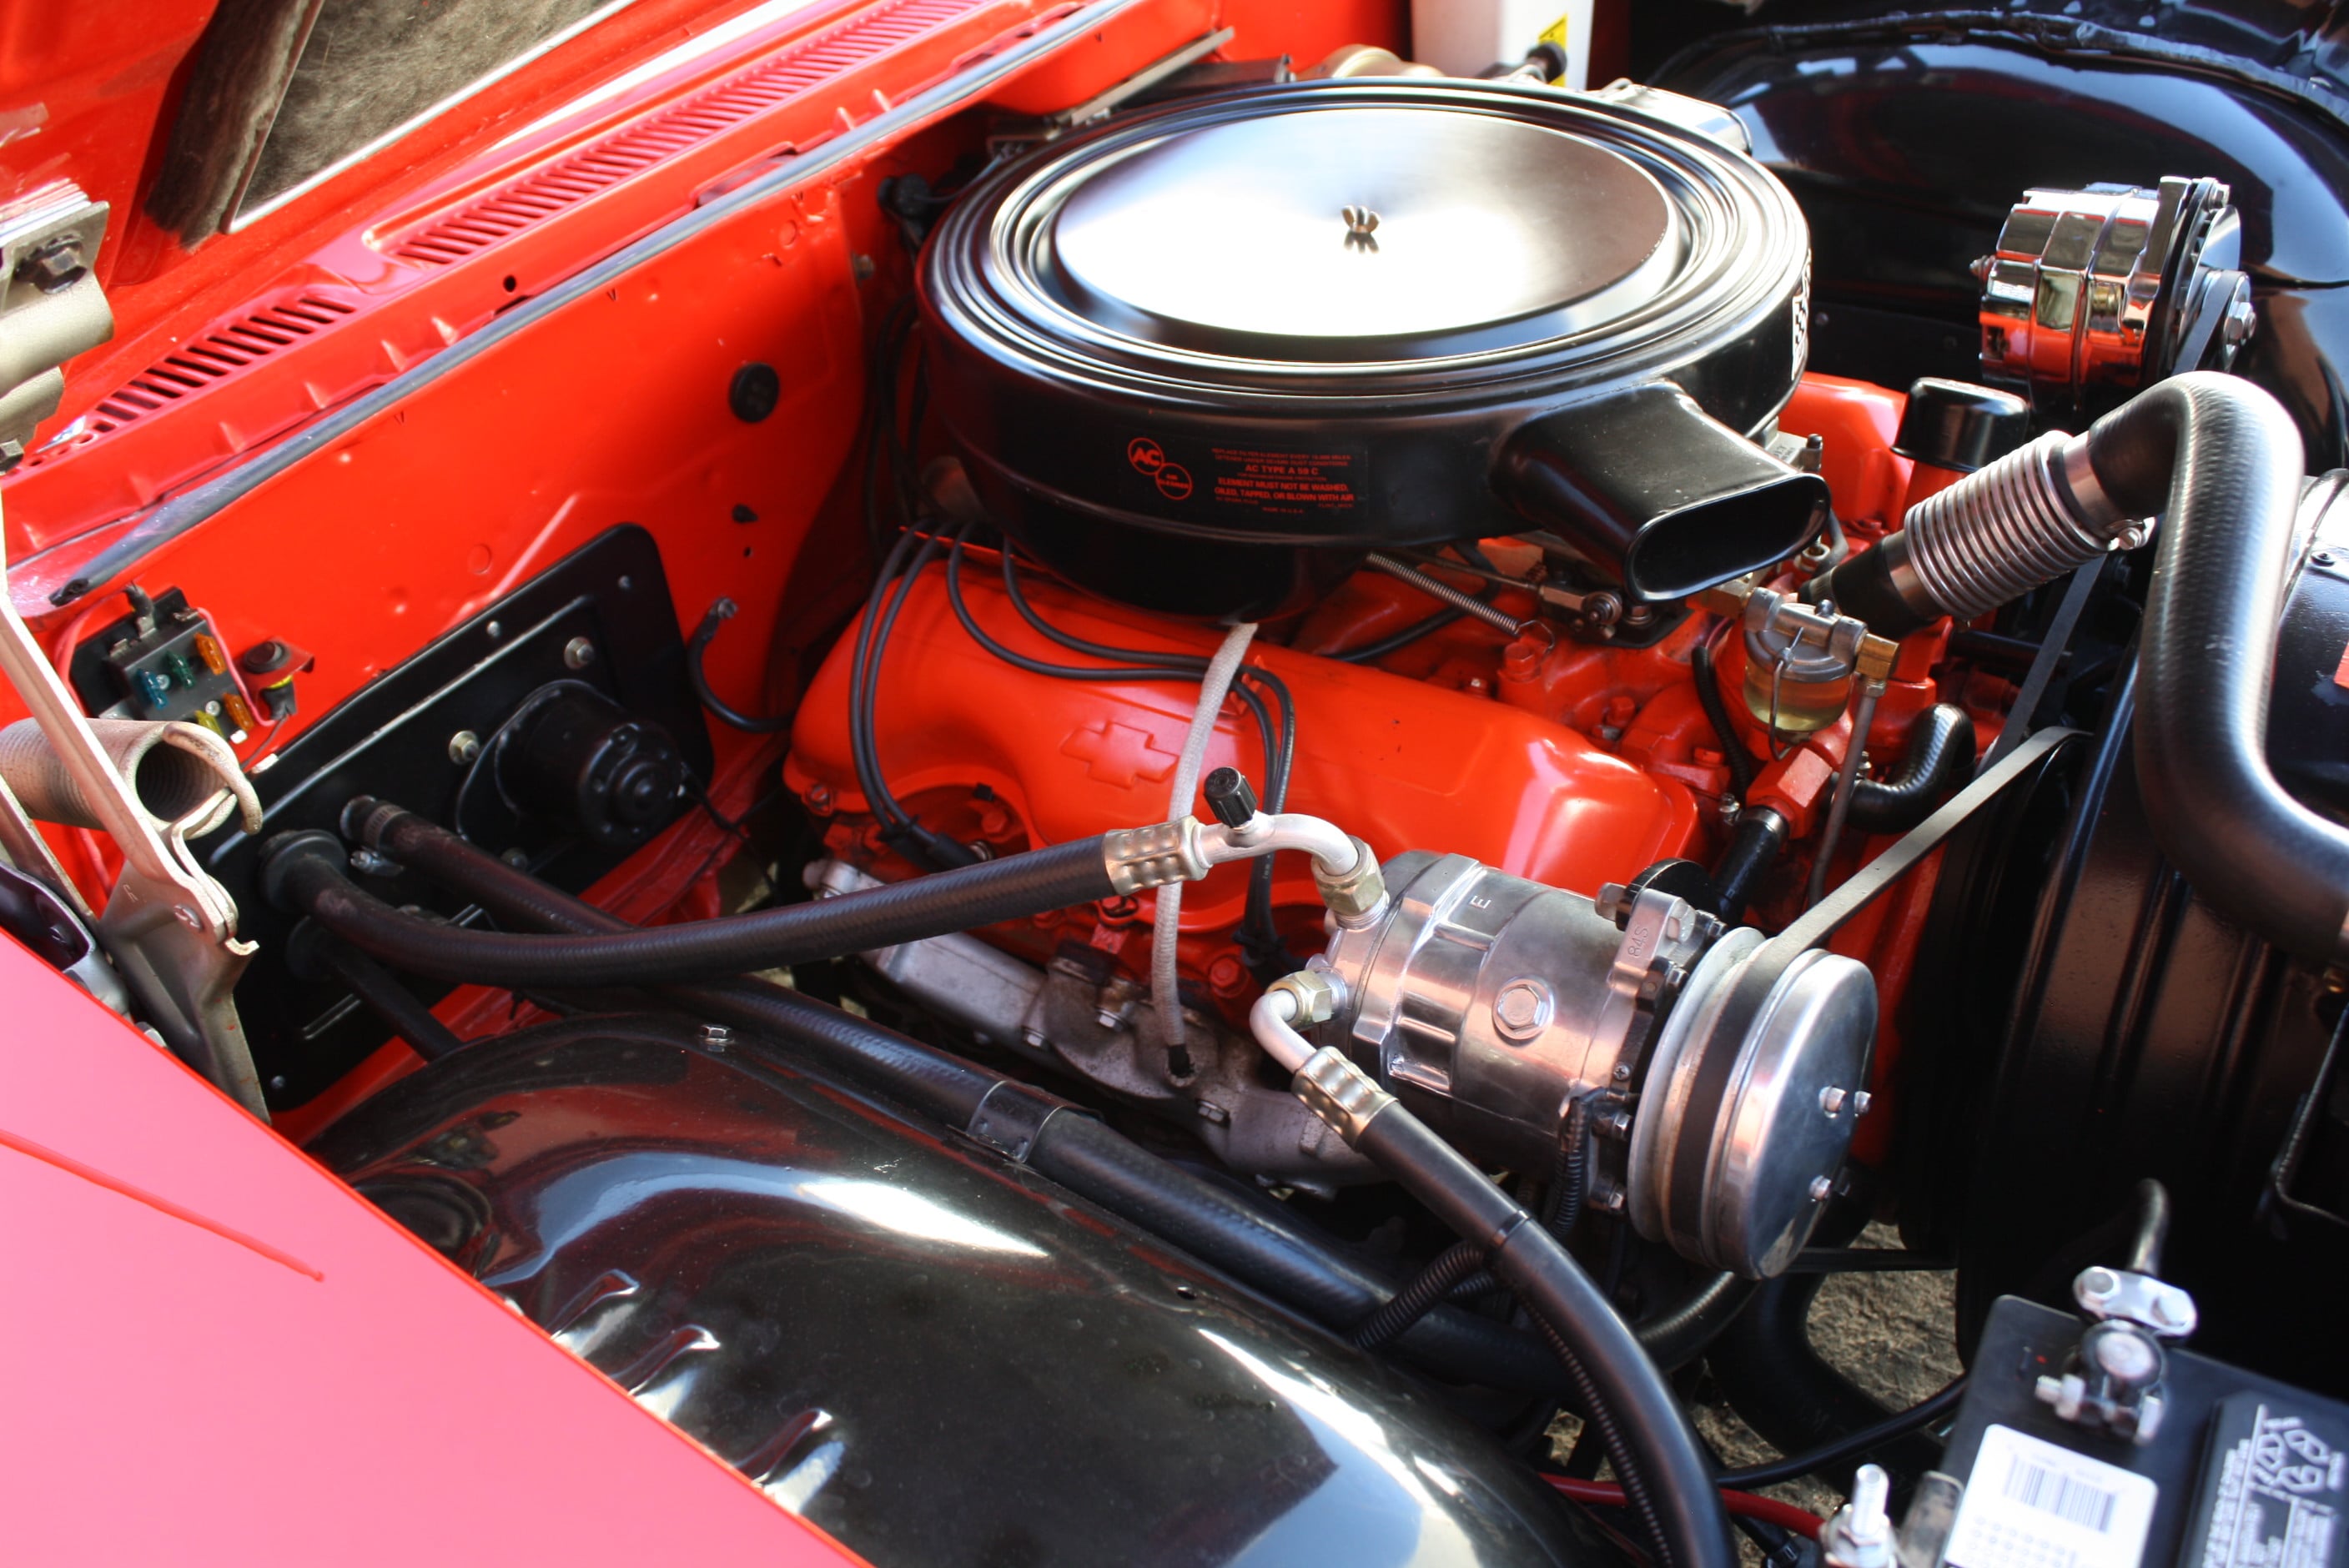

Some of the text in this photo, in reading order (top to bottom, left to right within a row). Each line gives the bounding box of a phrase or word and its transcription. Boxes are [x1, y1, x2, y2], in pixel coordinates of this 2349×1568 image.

[1132, 447, 1160, 466] AC
[1261, 466, 1285, 475] TYPE
[1218, 478, 1255, 488] ELEMENT
[1255, 481, 1280, 490] MUST
[1273, 492, 1285, 500] OR
